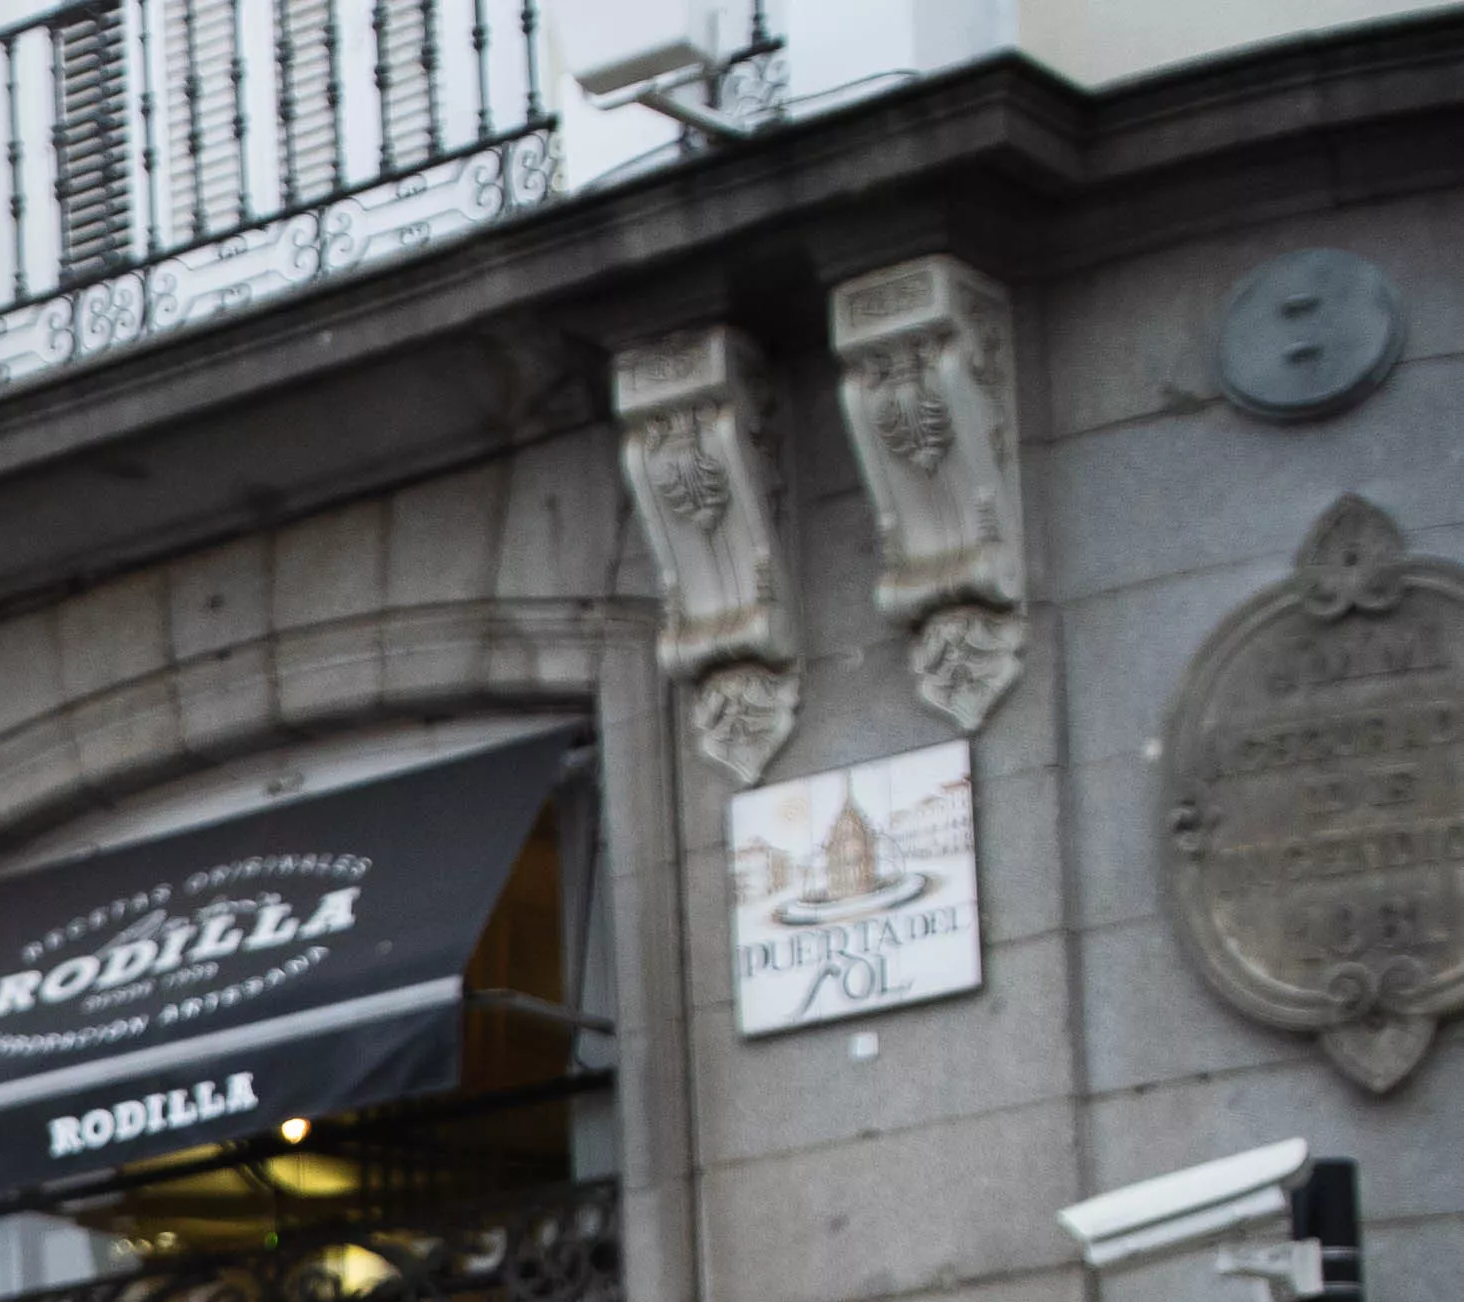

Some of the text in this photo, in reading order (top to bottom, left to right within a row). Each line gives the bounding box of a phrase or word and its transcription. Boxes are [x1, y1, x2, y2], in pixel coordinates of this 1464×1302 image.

[738, 907, 970, 977] PUERTA DEL
[47, 1071, 259, 1158] RODILLA
